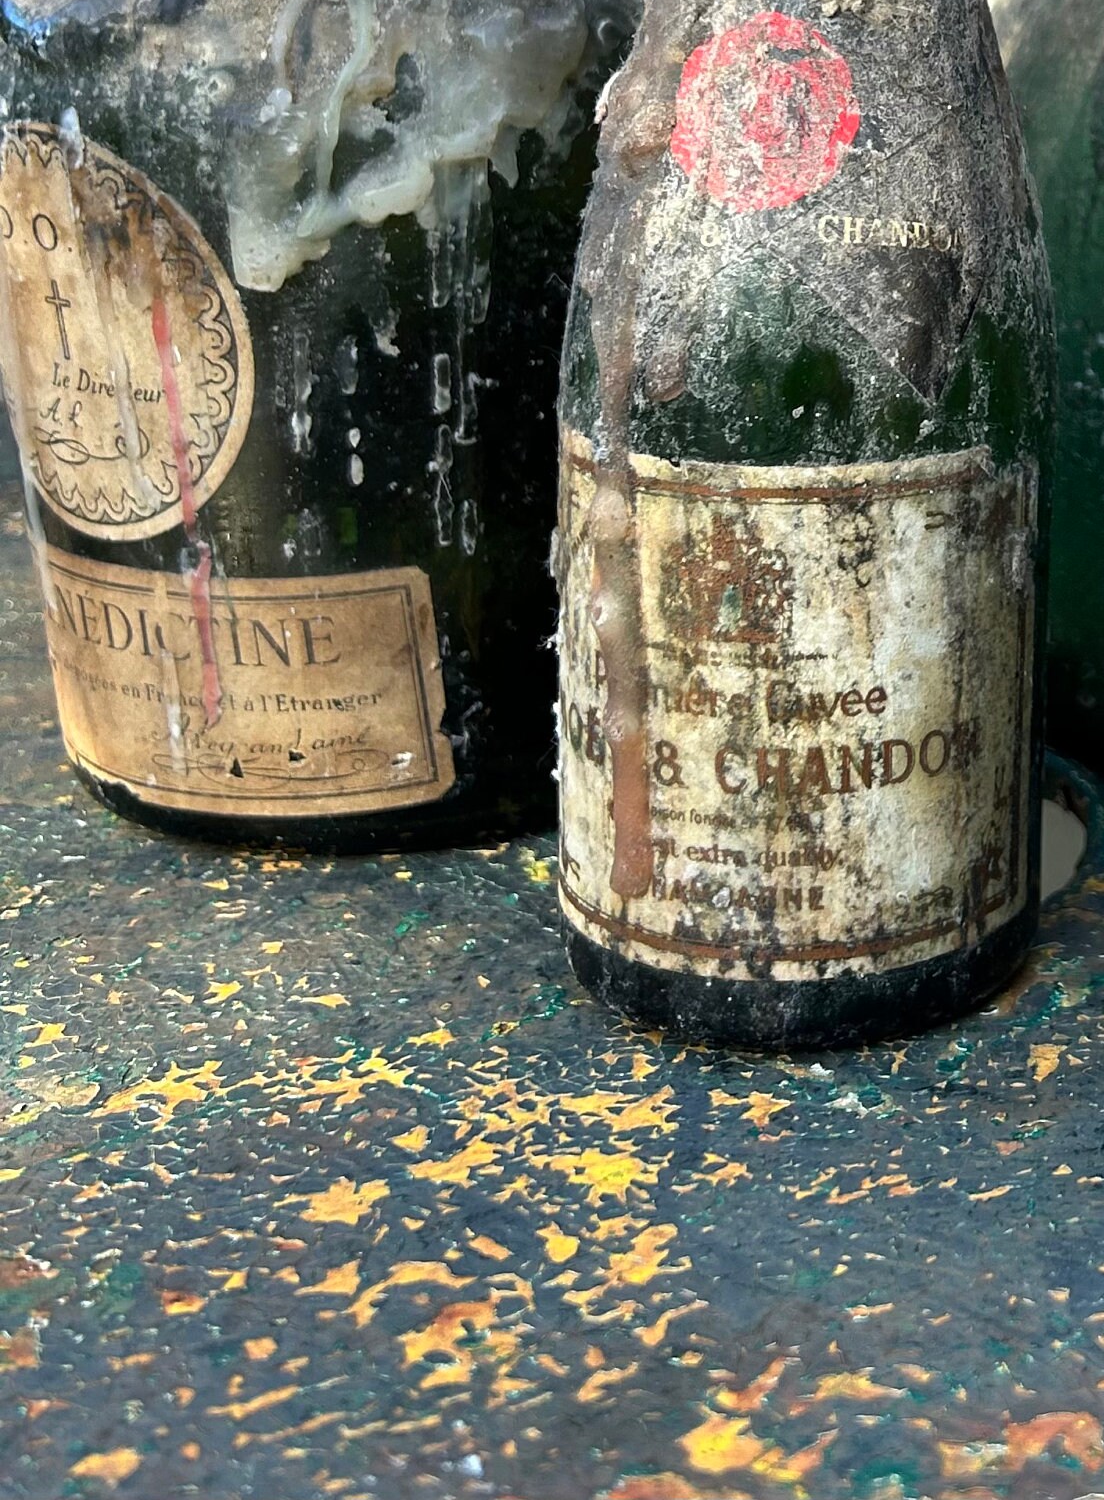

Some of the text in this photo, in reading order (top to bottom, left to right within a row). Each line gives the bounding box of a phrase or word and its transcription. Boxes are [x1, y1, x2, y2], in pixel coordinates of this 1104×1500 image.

[77, 368, 165, 403] Direeur
[121, 684, 141, 699] en
[654, 739, 685, 789] &
[714, 715, 980, 797] CHANDON
